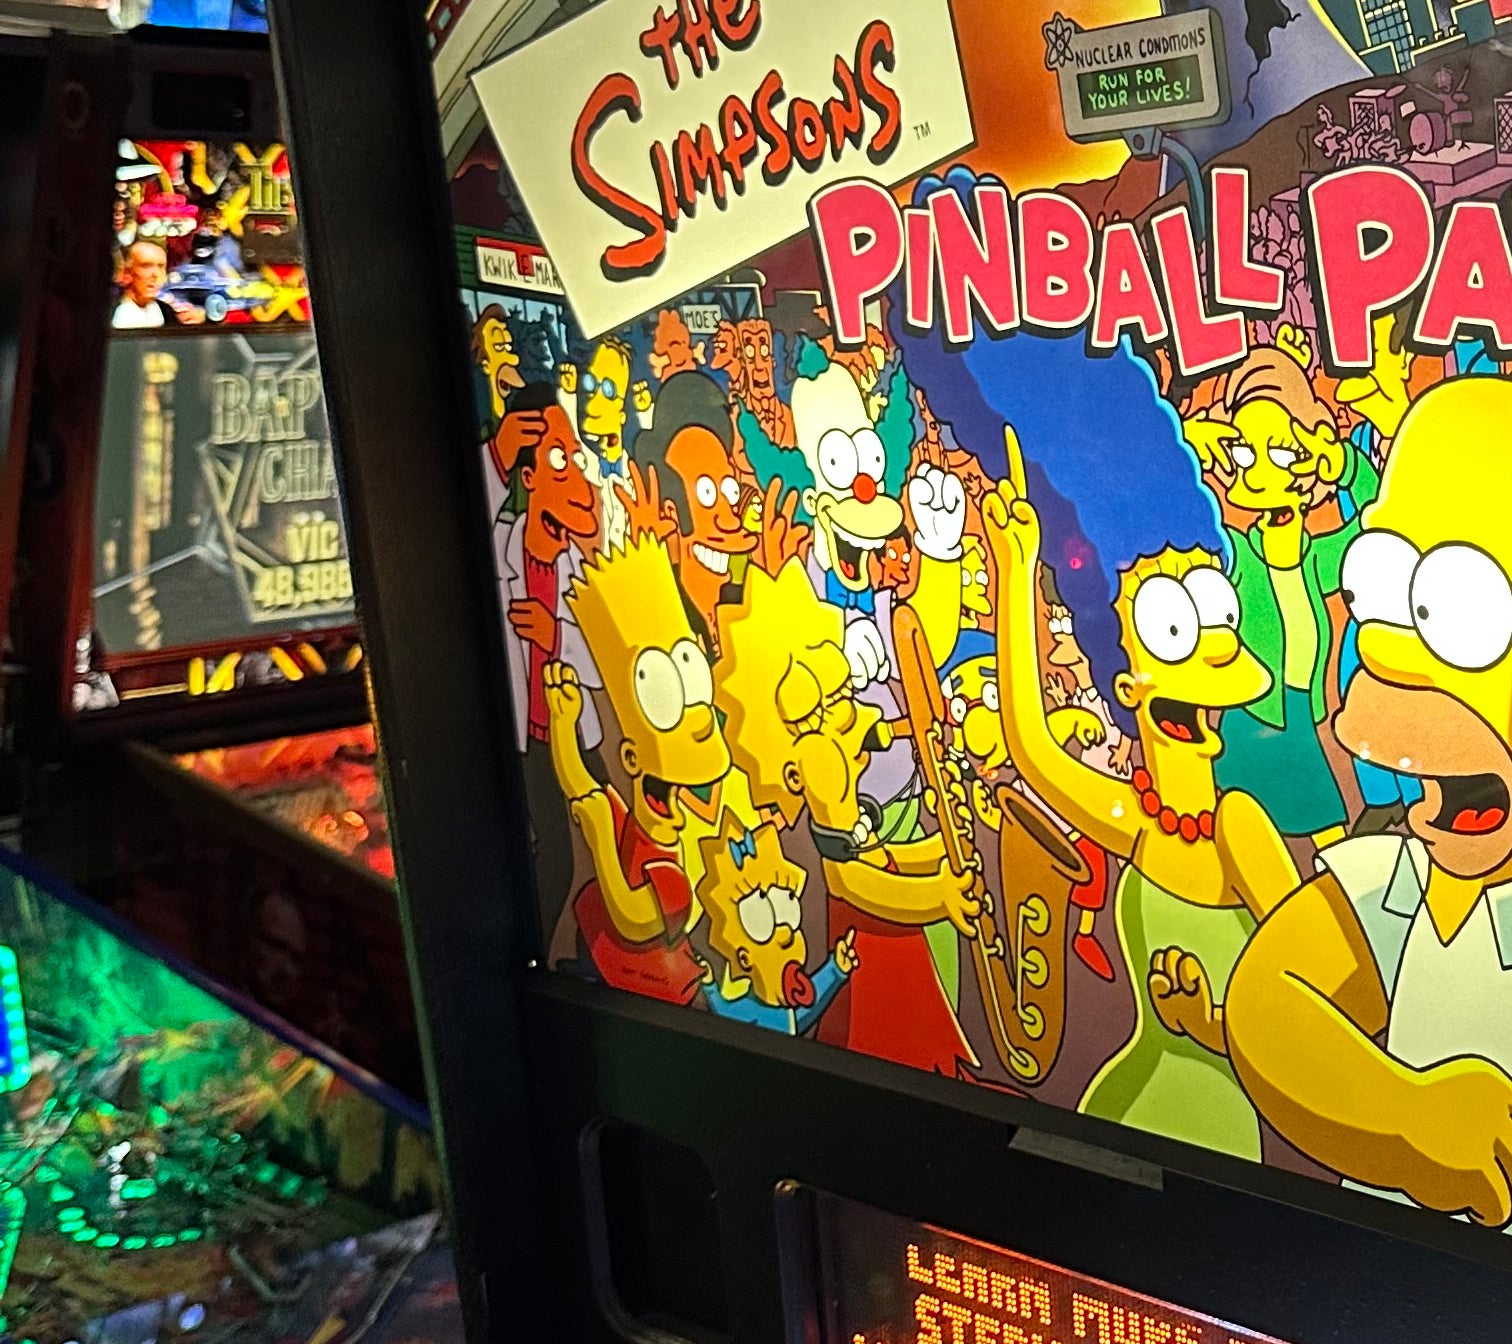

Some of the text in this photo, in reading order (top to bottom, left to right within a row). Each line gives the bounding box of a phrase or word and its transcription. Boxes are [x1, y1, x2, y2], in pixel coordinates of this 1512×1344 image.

[1075, 26, 1206, 70] NUCLEAR CONDITIONS
[1088, 76, 1192, 111] YOUR LIVES!
[1098, 67, 1167, 91] RUN FOR
[912, 121, 932, 139] TM
[571, 19, 902, 283] SIMPSONS
[483, 252, 517, 284] KWIK
[535, 256, 564, 290] MAR
[808, 166, 1285, 377] PINBALL
[685, 310, 721, 331] MOE'S
